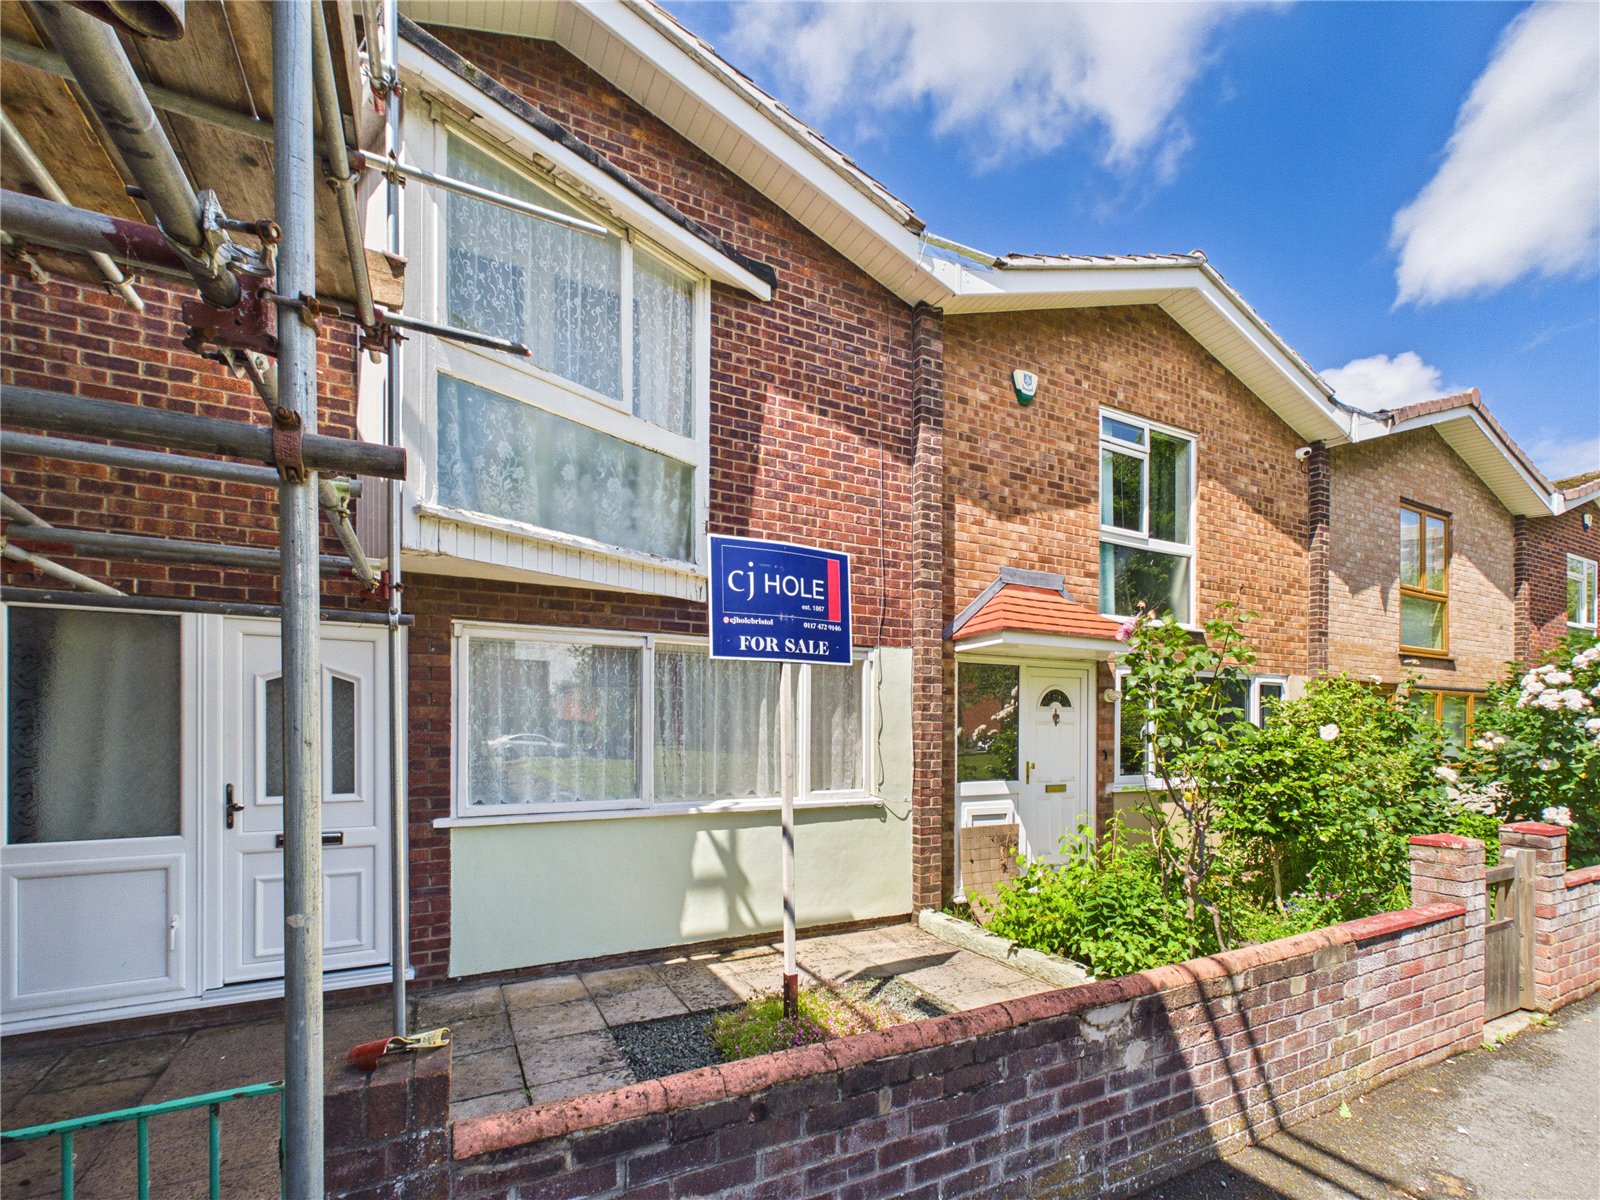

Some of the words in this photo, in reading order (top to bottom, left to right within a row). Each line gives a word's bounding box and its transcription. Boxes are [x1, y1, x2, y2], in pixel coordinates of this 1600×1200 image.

[764, 573, 825, 600] HOLE
[817, 623, 828, 631] 472
[739, 635, 780, 652] FOR
[784, 638, 830, 656] SALE
